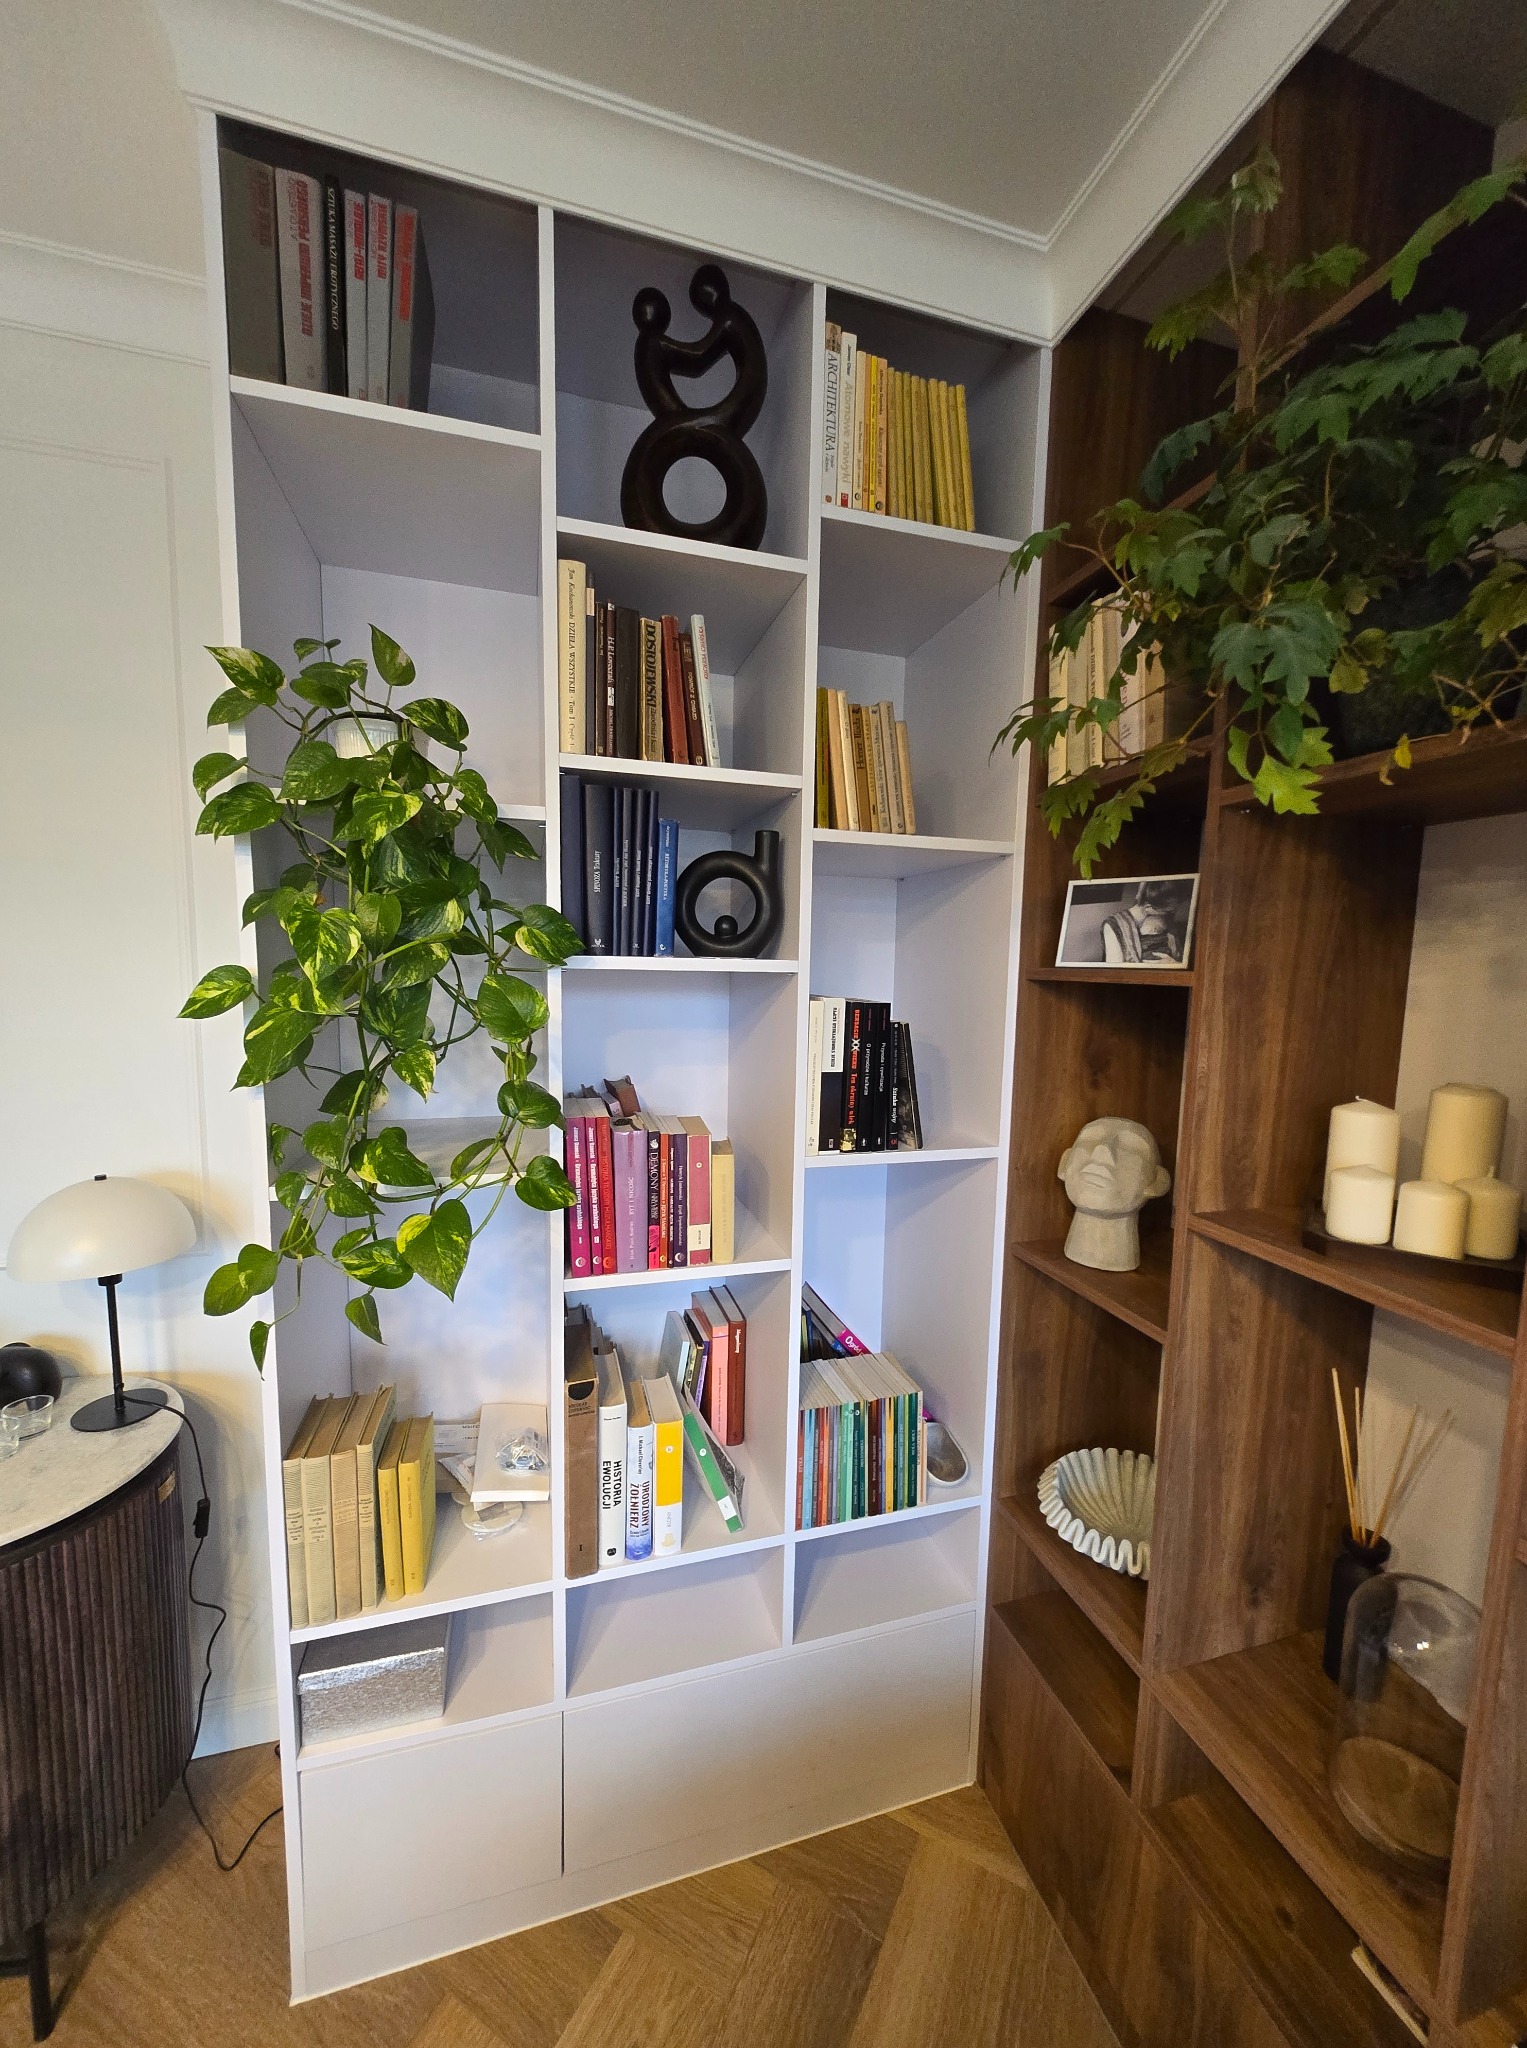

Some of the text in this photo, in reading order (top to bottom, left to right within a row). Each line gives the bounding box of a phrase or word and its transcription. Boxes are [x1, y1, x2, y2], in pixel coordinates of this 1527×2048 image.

[327, 187, 339, 331] SZTUKA MASAŻU EROTYCZNEGO
[826, 353, 838, 451] ARCHITEKTURA
[840, 381, 854, 485] Atomowe nawyki
[567, 568, 576, 580] Jan
[568, 622, 576, 650] DZIEŁA
[682, 641, 691, 663] LEM
[568, 651, 576, 694] WSZYSTKIE
[607, 651, 615, 683] Lovecraft
[645, 623, 656, 707] DOSTOJEWSKI
[687, 672, 695, 694] POWRÓT
[568, 701, 576, 715] Tom
[690, 699, 698, 721] GWIAZD
[853, 718, 866, 770] Homer Iliada
[594, 850, 602, 870] Traktaty
[852, 1038, 861, 1052] XX
[850, 1072, 858, 1084] Ten
[878, 1066, 886, 1092] cywilizacja
[848, 1085, 857, 1109] okrutny
[848, 1110, 857, 1125] wiek
[890, 1108, 898, 1124] wojny
[574, 1164, 582, 1189] Gramatyka
[590, 1164, 598, 1188] Gramatyka
[650, 1152, 659, 1191] DEMONY
[590, 1188, 599, 1204] języka
[602, 1181, 610, 1206] FILOZOFII
[576, 1205, 584, 1230] arabskiego
[592, 1204, 600, 1230] arabskiego
[604, 1206, 613, 1250] MUZUŁMAŃSKIEJ
[602, 1461, 612, 1510] EWOLUCJI
[612, 1460, 622, 1507] HISTORIA
[629, 1483, 642, 1529] ŻOŁNIERZ
[641, 1481, 650, 1526] URODZONY
